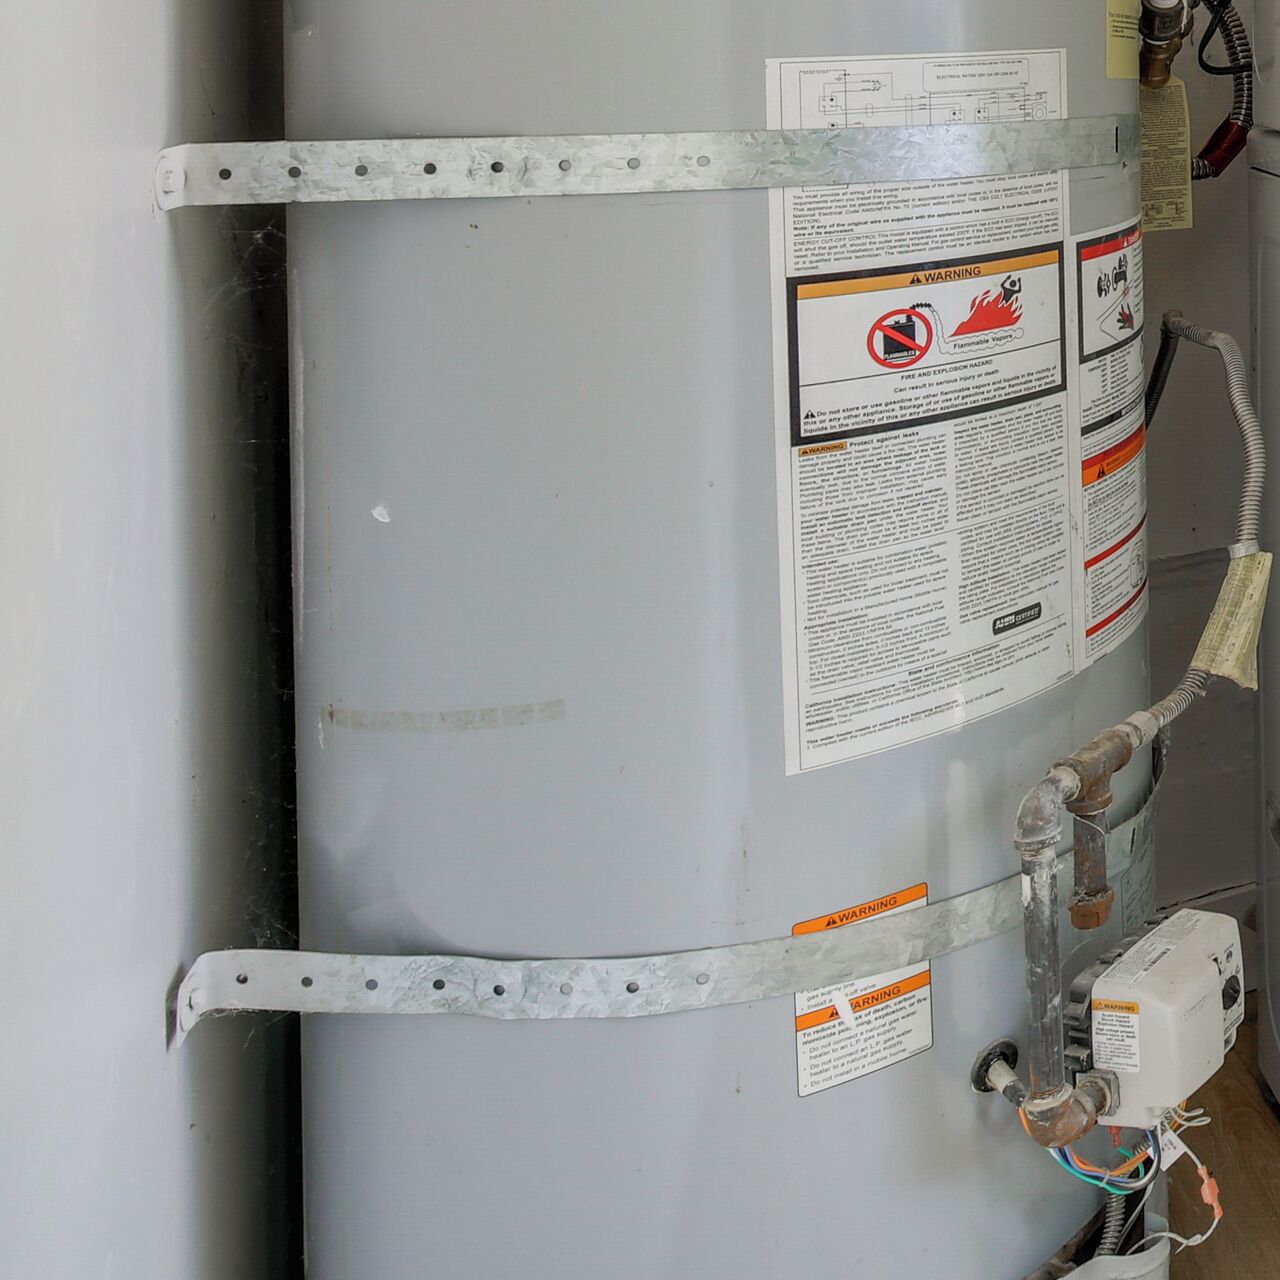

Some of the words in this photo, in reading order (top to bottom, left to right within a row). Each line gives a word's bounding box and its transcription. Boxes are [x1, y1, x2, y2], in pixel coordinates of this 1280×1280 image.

[924, 266, 981, 282] WARNING
[953, 338, 989, 349] Flammable
[992, 334, 1013, 343] Vapors
[901, 373, 916, 381] FIRE
[918, 370, 931, 378] AND
[933, 363, 968, 375] EXPLOSION
[969, 359, 993, 368] HAZARD
[909, 382, 926, 390] result
[936, 377, 958, 385] serious
[984, 368, 999, 376] death
[884, 397, 912, 407] gasoline
[940, 386, 970, 396] flammable
[972, 382, 990, 390] vapors
[899, 402, 923, 411] Storage
[961, 391, 985, 401] gasoline
[1008, 378, 1033, 390] flammable
[803, 425, 828, 433] liquids
[851, 417, 875, 426] vicinity
[940, 402, 968, 412] appliance
[981, 394, 997, 403] result
[809, 444, 843, 454] WARNING
[850, 438, 874, 447] Protect
[876, 433, 900, 444] against
[902, 431, 919, 439] leaks
[838, 897, 897, 922] WARNING
[807, 993, 819, 1002] gas
[807, 999, 827, 1009] Install
[851, 986, 900, 1010] ARNING
[1104, 1003, 1135, 1011] WARNING
[813, 1024, 836, 1036] reduce
[864, 1010, 871, 1018] of
[873, 1004, 892, 1015] death,
[893, 995, 916, 1007] carbon
[803, 1032, 836, 1046] monoxide
[809, 1046, 819, 1054] Do
[821, 1041, 832, 1049] not
[833, 1032, 858, 1047] connect
[865, 1024, 886, 1036] natural
[888, 1018, 899, 1027] gas
[901, 1010, 917, 1021] water
[809, 1050, 830, 1060] heater
[876, 1026, 896, 1037] supply
[822, 1075, 832, 1083] not
[834, 1067, 853, 1079] install
[867, 1055, 887, 1067] mobile
